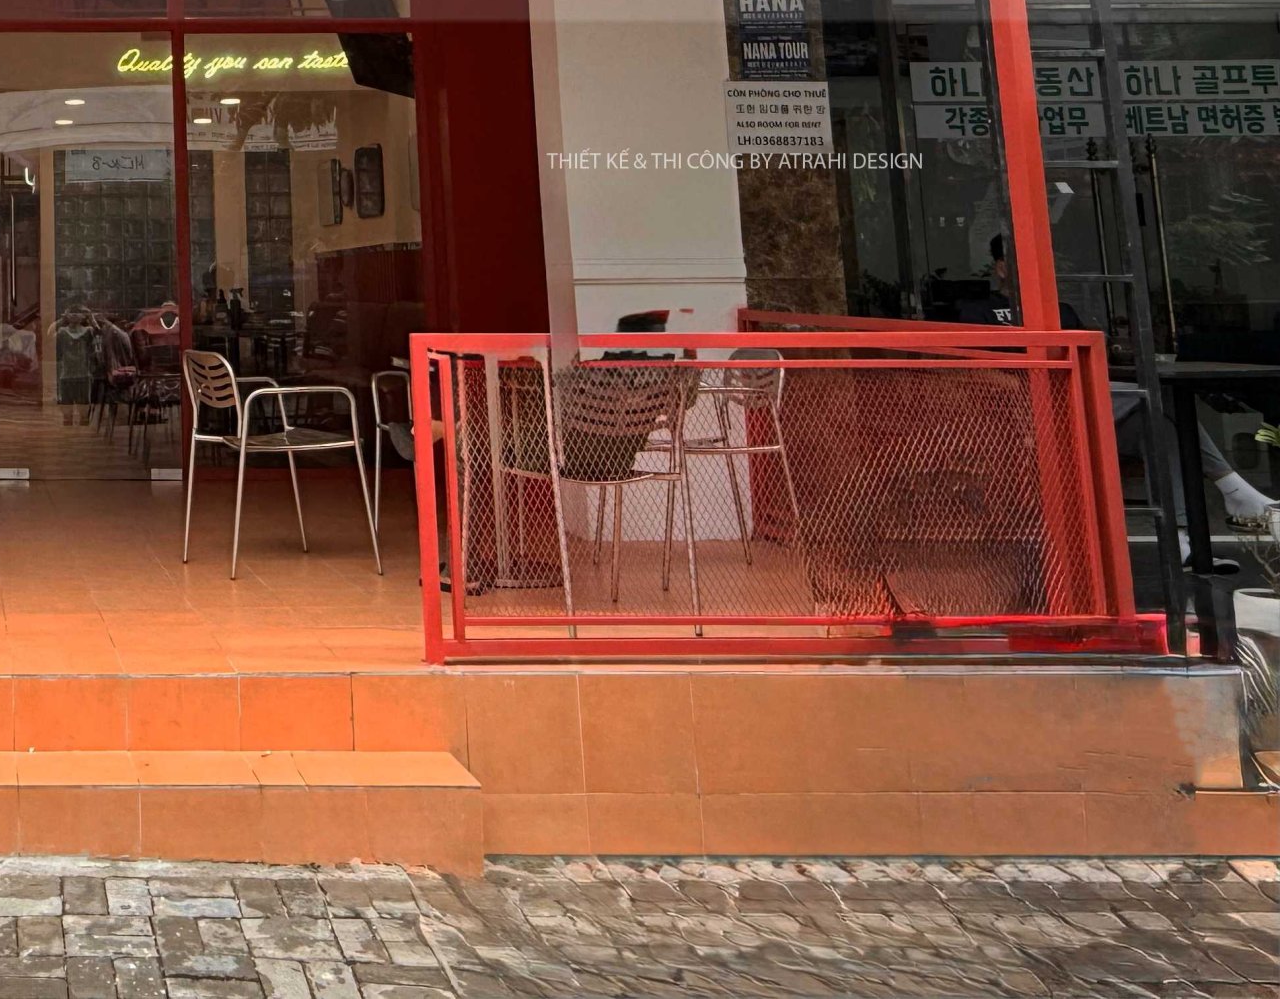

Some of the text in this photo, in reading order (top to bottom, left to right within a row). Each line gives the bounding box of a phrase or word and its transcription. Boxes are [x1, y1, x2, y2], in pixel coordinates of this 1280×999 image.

[117, 48, 202, 79] Qualty
[204, 56, 247, 79] you
[743, 42, 809, 60] NANA TOUR
[783, 89, 801, 98] CHO
[1124, 64, 1280, 96] 하나 골프투
[1197, 104, 1266, 134] 면허증
